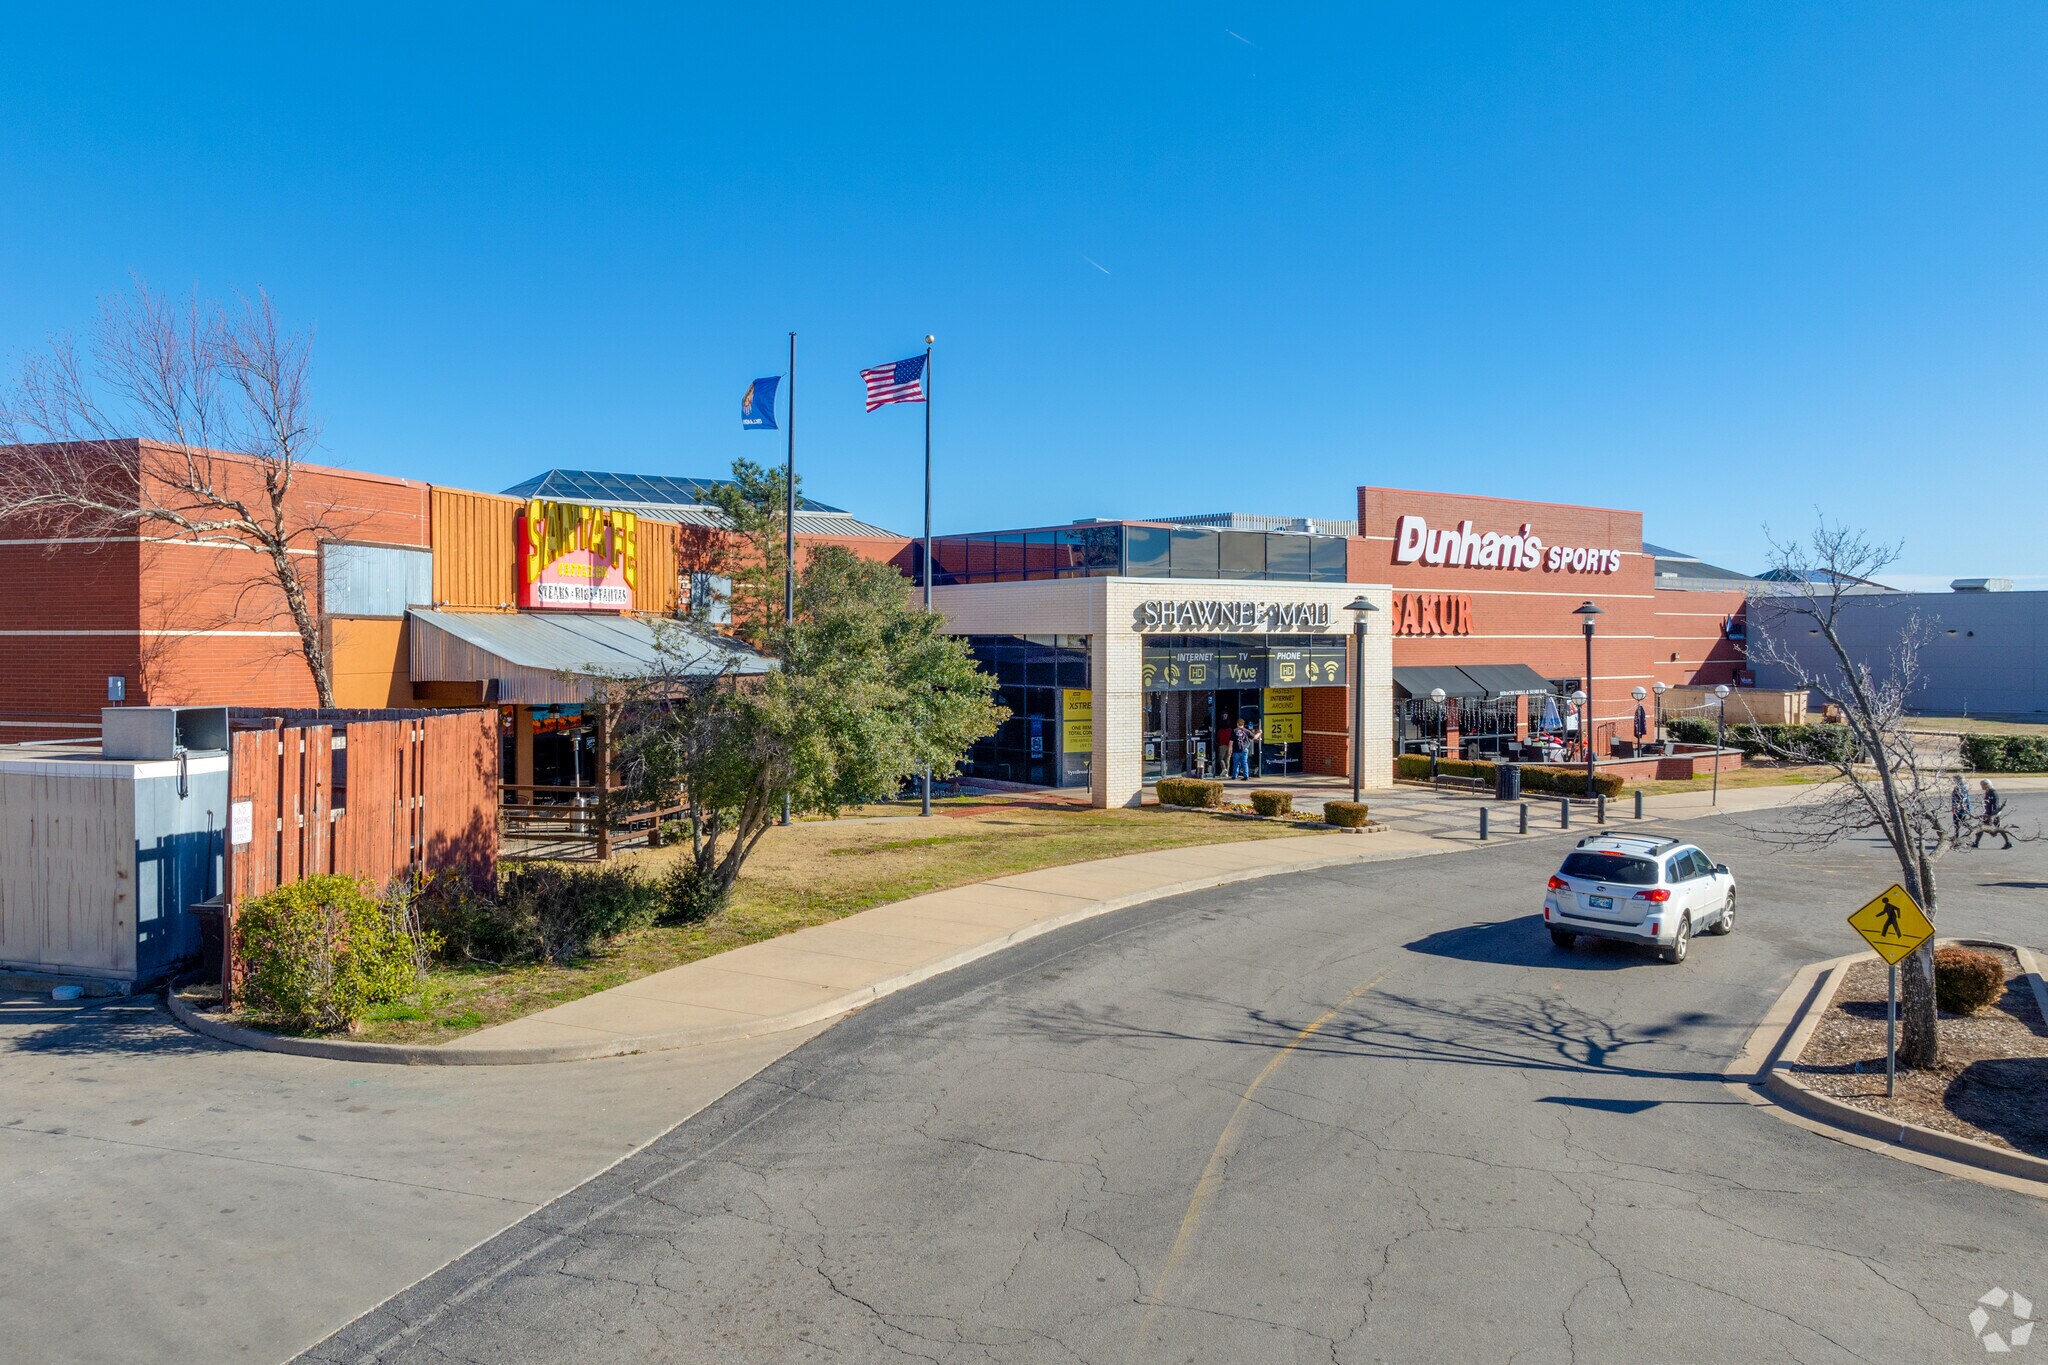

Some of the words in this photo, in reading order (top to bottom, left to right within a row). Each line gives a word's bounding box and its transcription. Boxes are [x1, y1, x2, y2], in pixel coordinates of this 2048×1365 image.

[528, 499, 606, 583] SANTA
[610, 510, 637, 591] FE
[1397, 515, 1542, 569] Dunham's
[1549, 546, 1621, 572] SPORTS
[558, 563, 593, 578] CATTLE
[538, 585, 569, 600] STEAKS
[575, 587, 594, 600] RIBS
[1144, 600, 1266, 626] SHAWNEE
[1277, 602, 1338, 626] MALL
[1392, 594, 1474, 635] SAKUR
[1177, 653, 1213, 661] INTERNET
[1277, 652, 1301, 660] PHONE
[1192, 668, 1203, 677] HD
[1228, 664, 1257, 683] Vyve
[1282, 667, 1292, 676] HD
[1069, 702, 1092, 710] XSTRE
[1271, 724, 1282, 734] 25
